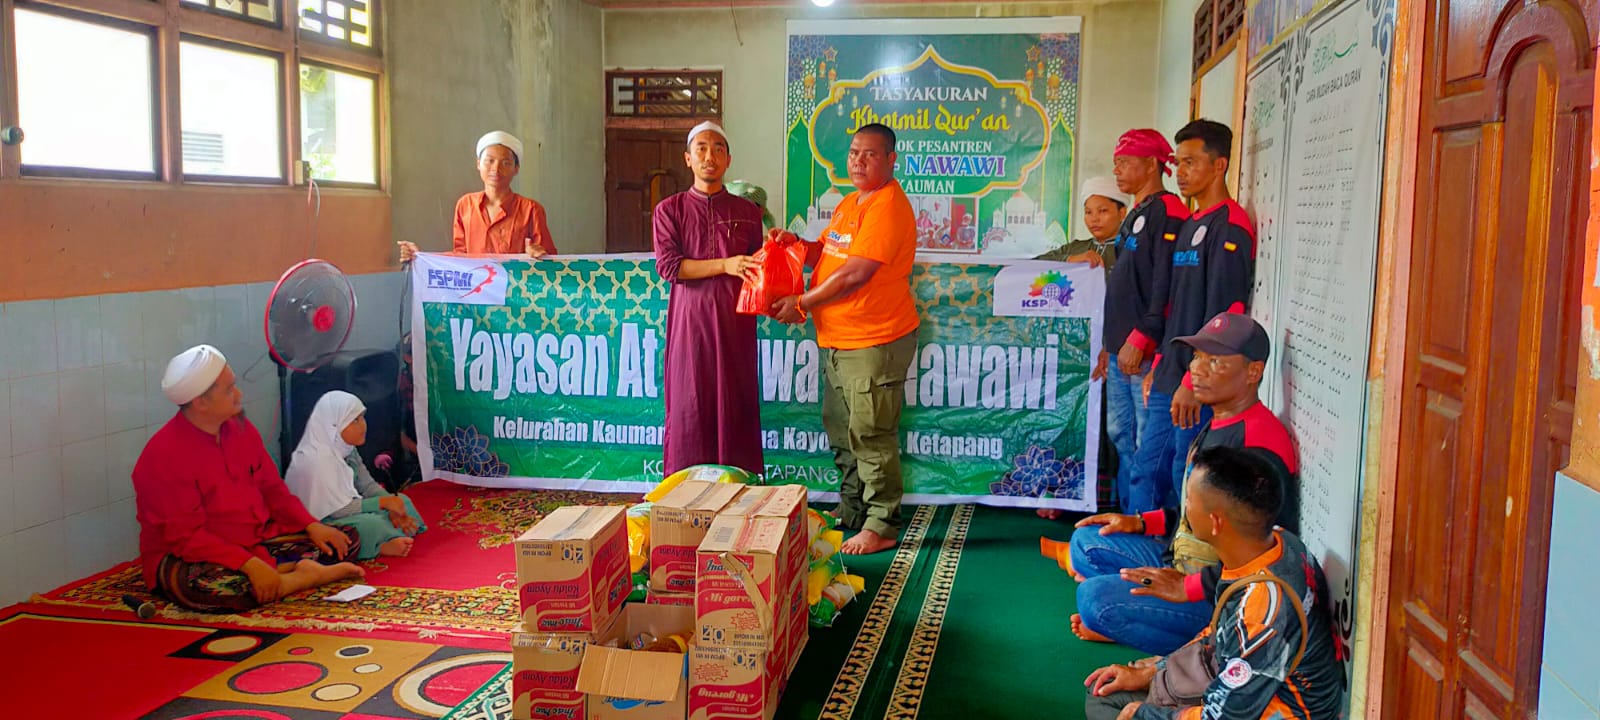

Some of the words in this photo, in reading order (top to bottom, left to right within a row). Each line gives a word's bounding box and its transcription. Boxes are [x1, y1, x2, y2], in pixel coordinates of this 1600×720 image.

[869, 86, 988, 101] TASYAKURAN
[918, 140, 992, 152] PESANTREN
[905, 154, 1006, 176] NAWAWI
[428, 269, 473, 287] FSPMI
[450, 317, 609, 400] Yayasan
[616, 322, 658, 398] At
[493, 416, 588, 442] Kelurahan
[783, 427, 831, 453] Kayo
[906, 431, 1003, 460] Ketapang
[763, 463, 838, 485] TAPANG
